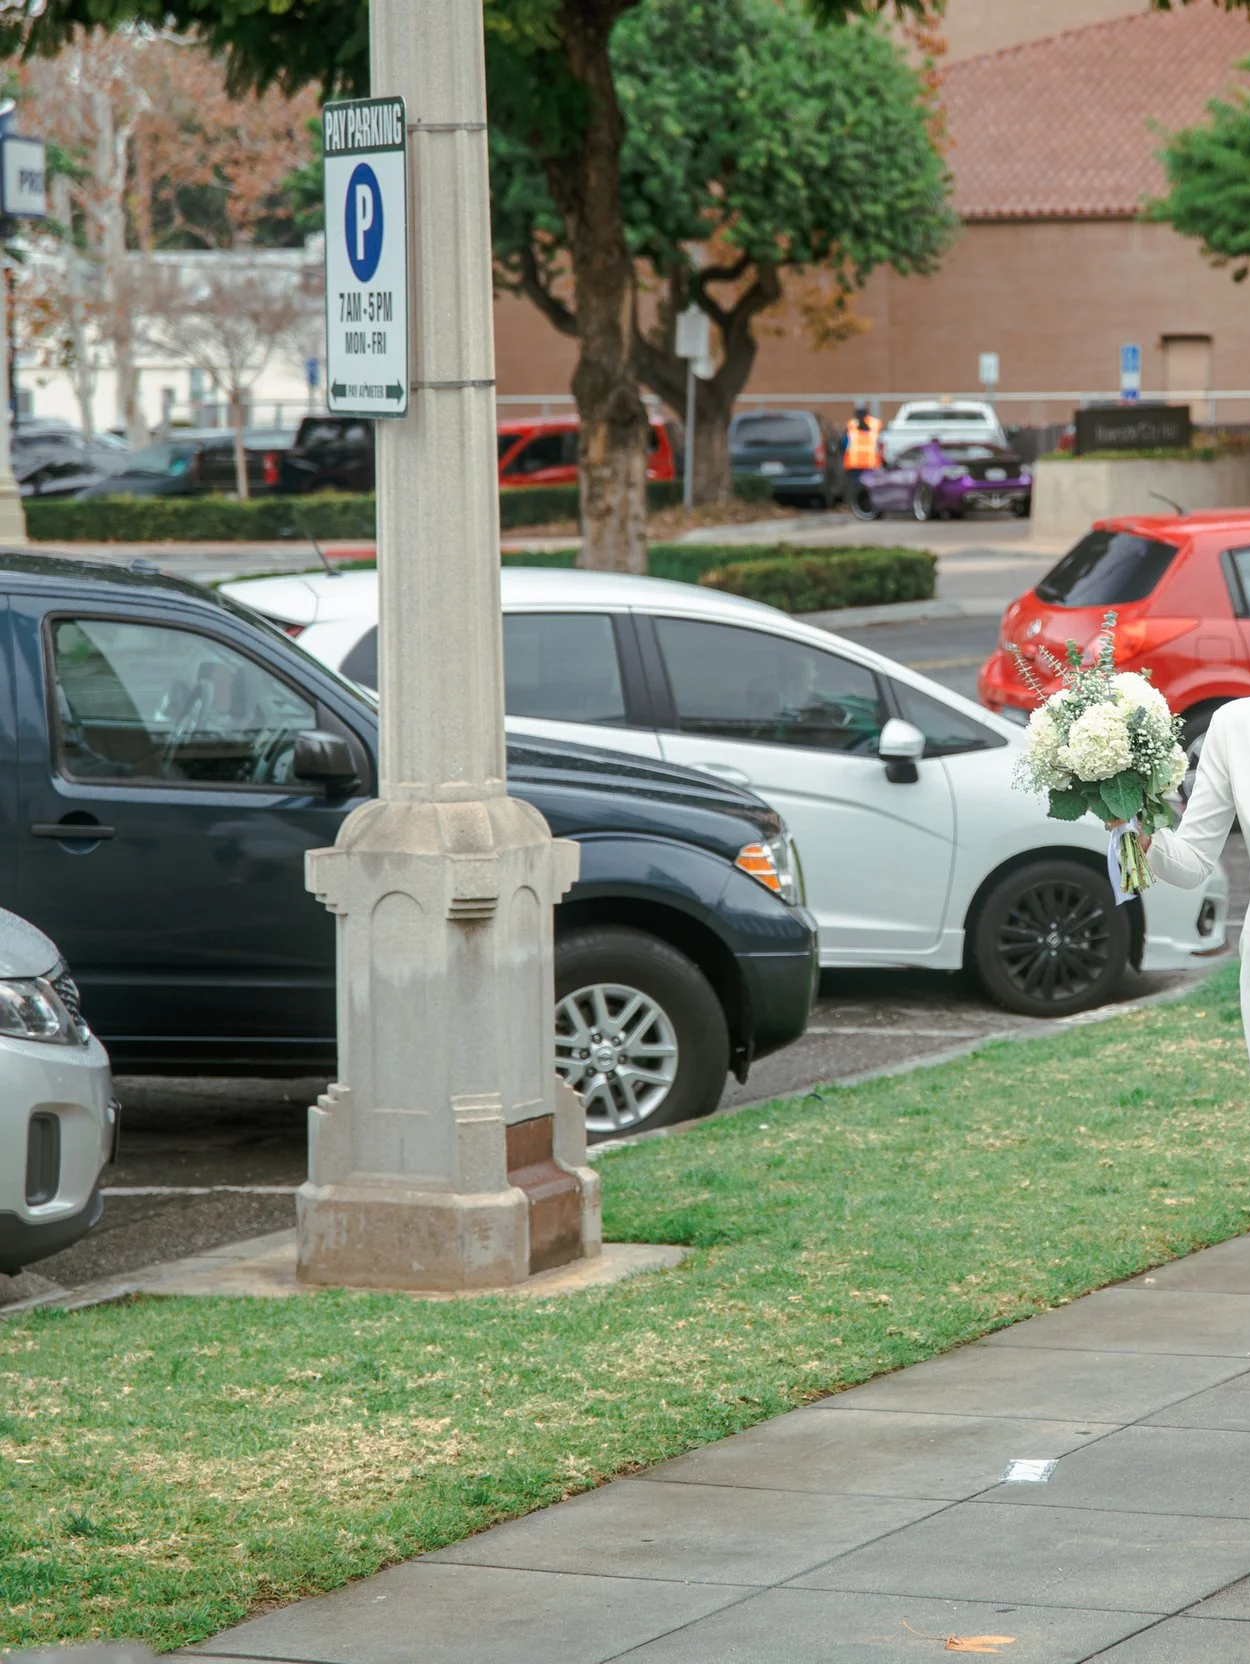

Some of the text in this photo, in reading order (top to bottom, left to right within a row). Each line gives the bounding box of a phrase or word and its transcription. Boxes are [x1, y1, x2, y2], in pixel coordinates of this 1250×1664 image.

[325, 103, 402, 151] PAY PARKING
[355, 183, 374, 261] P
